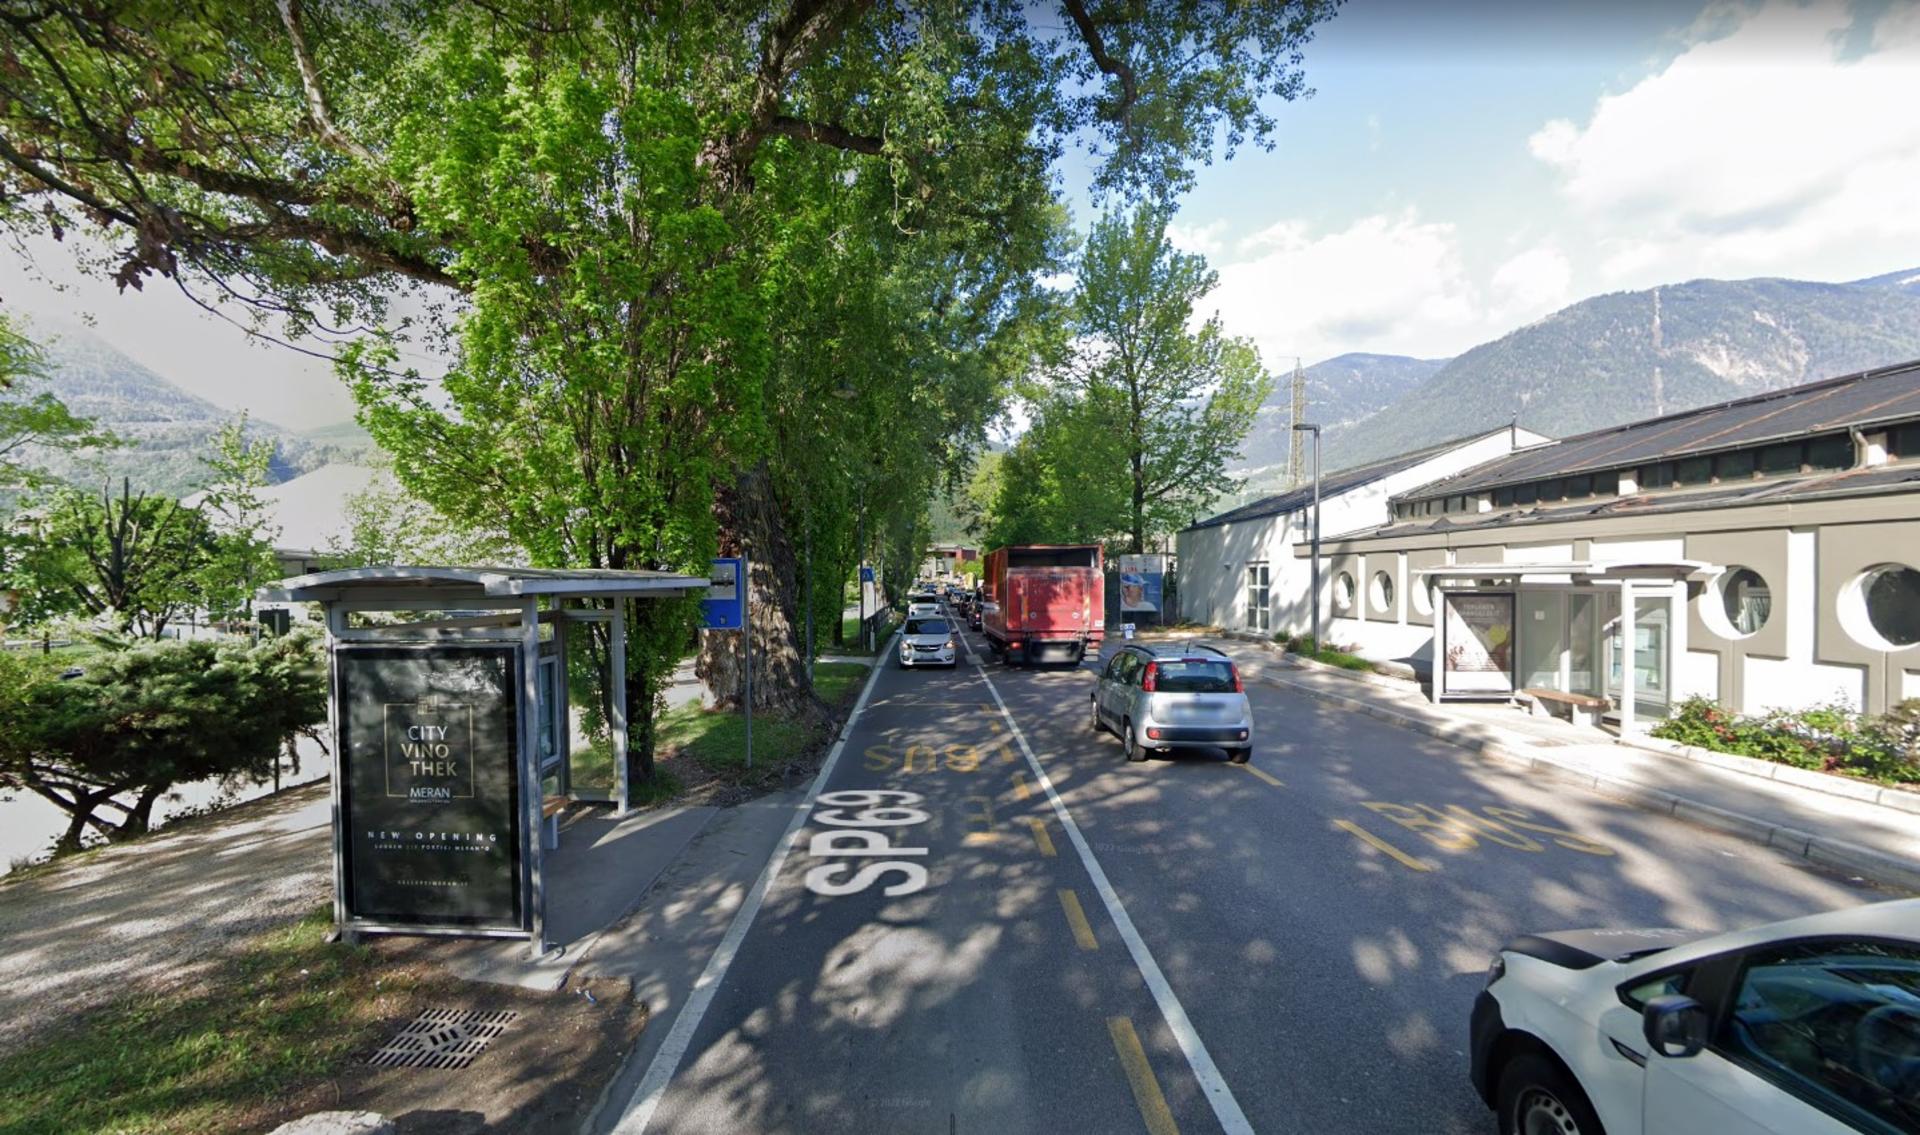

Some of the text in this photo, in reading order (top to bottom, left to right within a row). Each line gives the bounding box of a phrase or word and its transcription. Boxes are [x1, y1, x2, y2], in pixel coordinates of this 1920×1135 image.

[407, 725, 448, 741] CITY
[400, 743, 450, 759] VINO
[863, 742, 980, 774] BUS
[409, 761, 458, 777] THEK
[409, 787, 451, 798] MERAN
[367, 831, 497, 842] NEW OPENING
[1358, 800, 1616, 857] BUS
[805, 789, 932, 897] SP69
